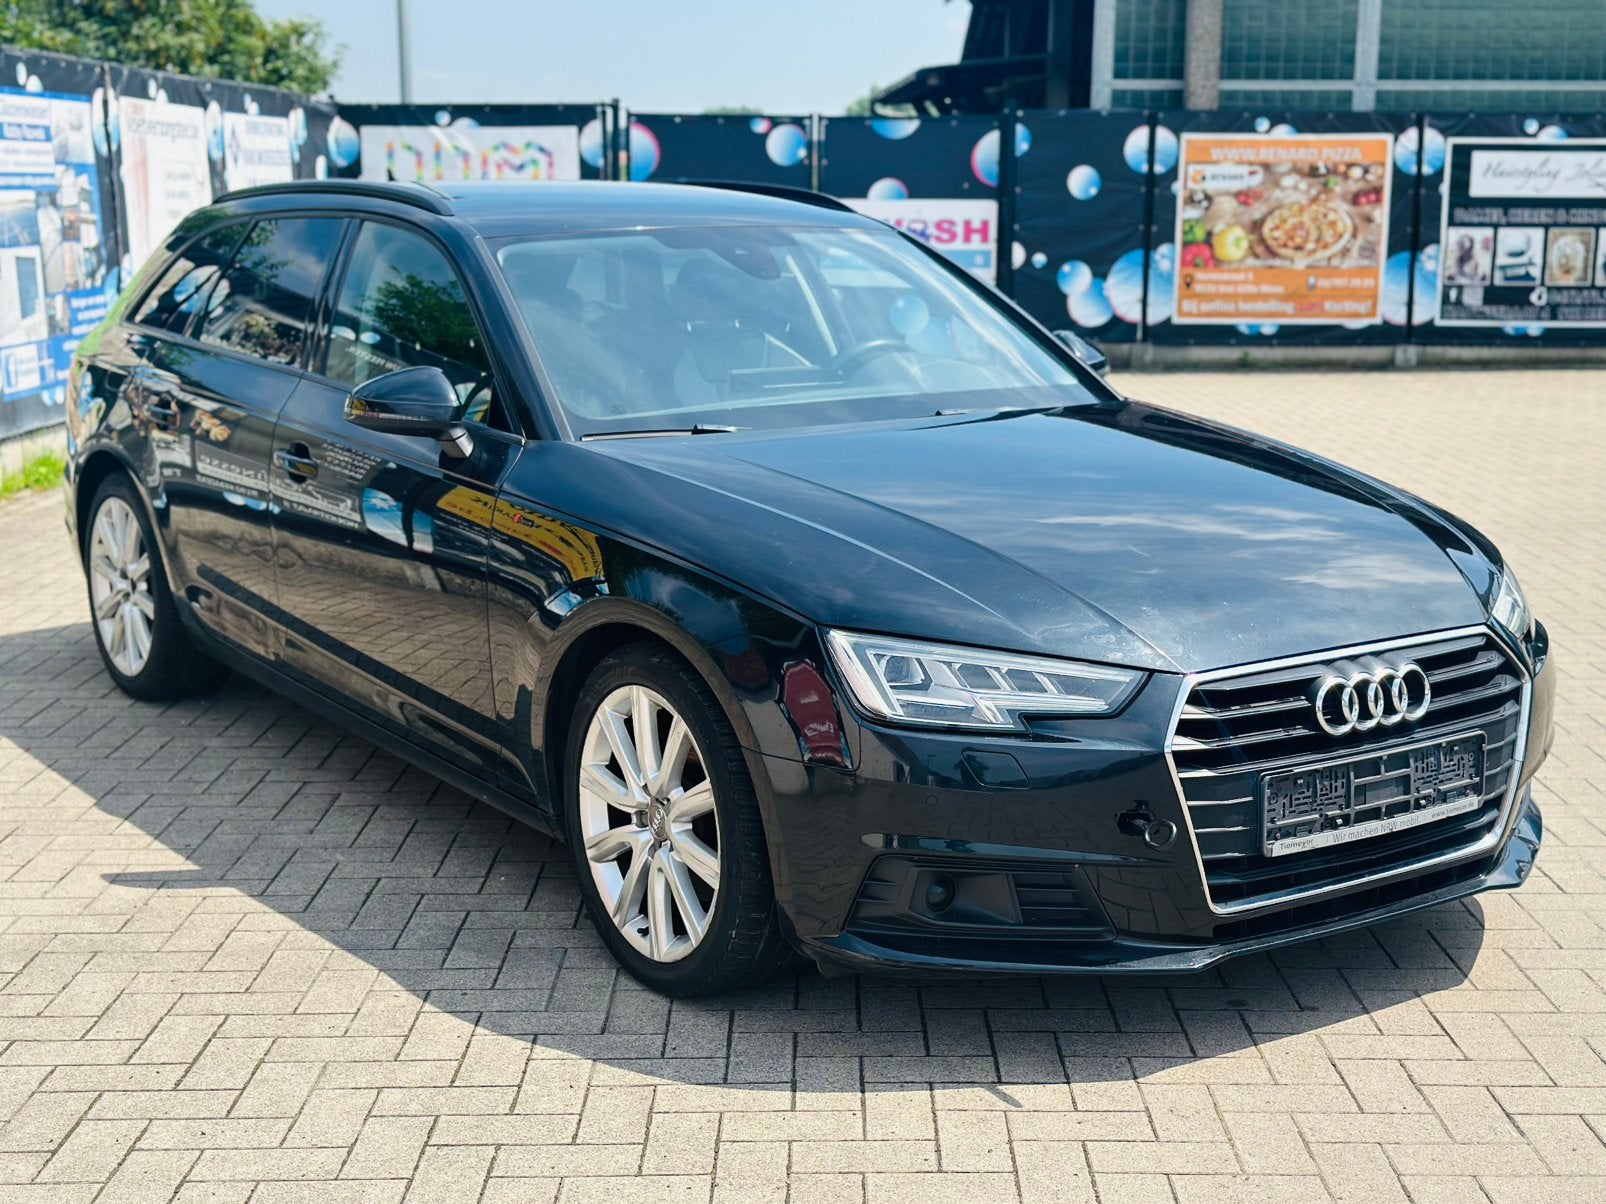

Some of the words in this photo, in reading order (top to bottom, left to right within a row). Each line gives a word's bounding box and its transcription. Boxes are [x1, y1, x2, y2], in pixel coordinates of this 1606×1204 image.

[1280, 838, 1314, 850] Tiemeyer
[1332, 832, 1347, 843] Wir
[1348, 826, 1380, 840] machen
[1380, 820, 1399, 833] NRW
